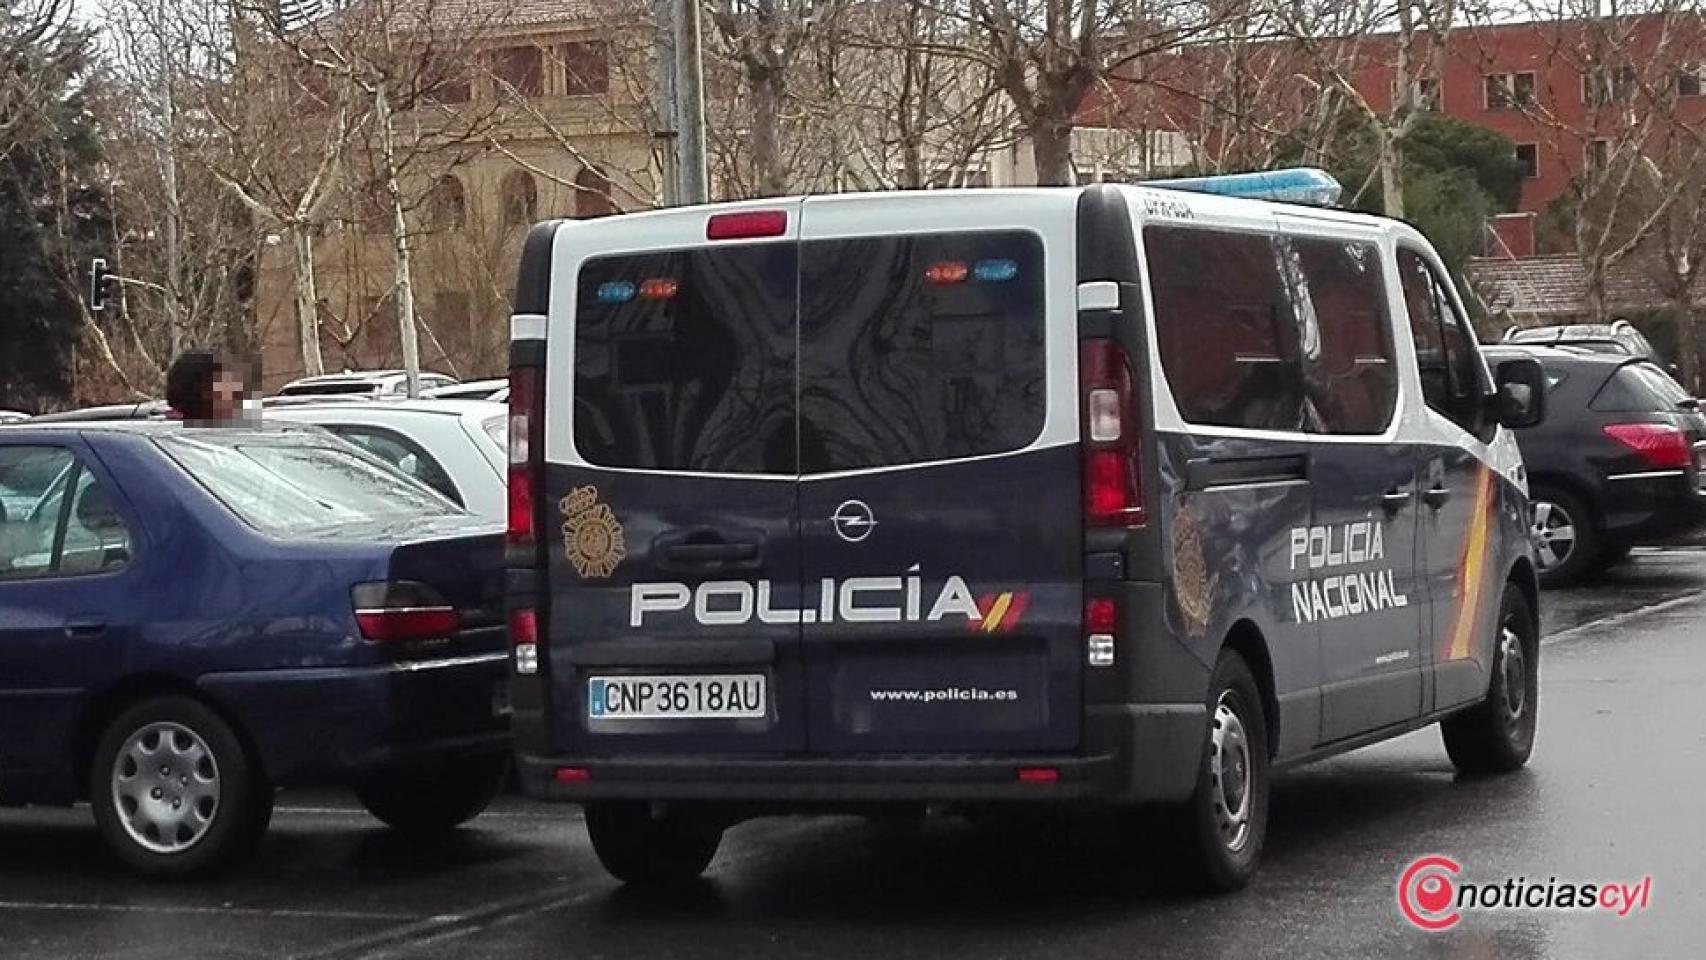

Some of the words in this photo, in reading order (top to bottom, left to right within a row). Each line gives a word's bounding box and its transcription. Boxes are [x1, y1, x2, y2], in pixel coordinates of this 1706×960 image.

[1290, 510, 1384, 570] POLICÍA
[629, 564, 982, 627] POLICÍA
[1291, 568, 1408, 624] NACIONAL
[870, 687, 1018, 702] www.policia.es
